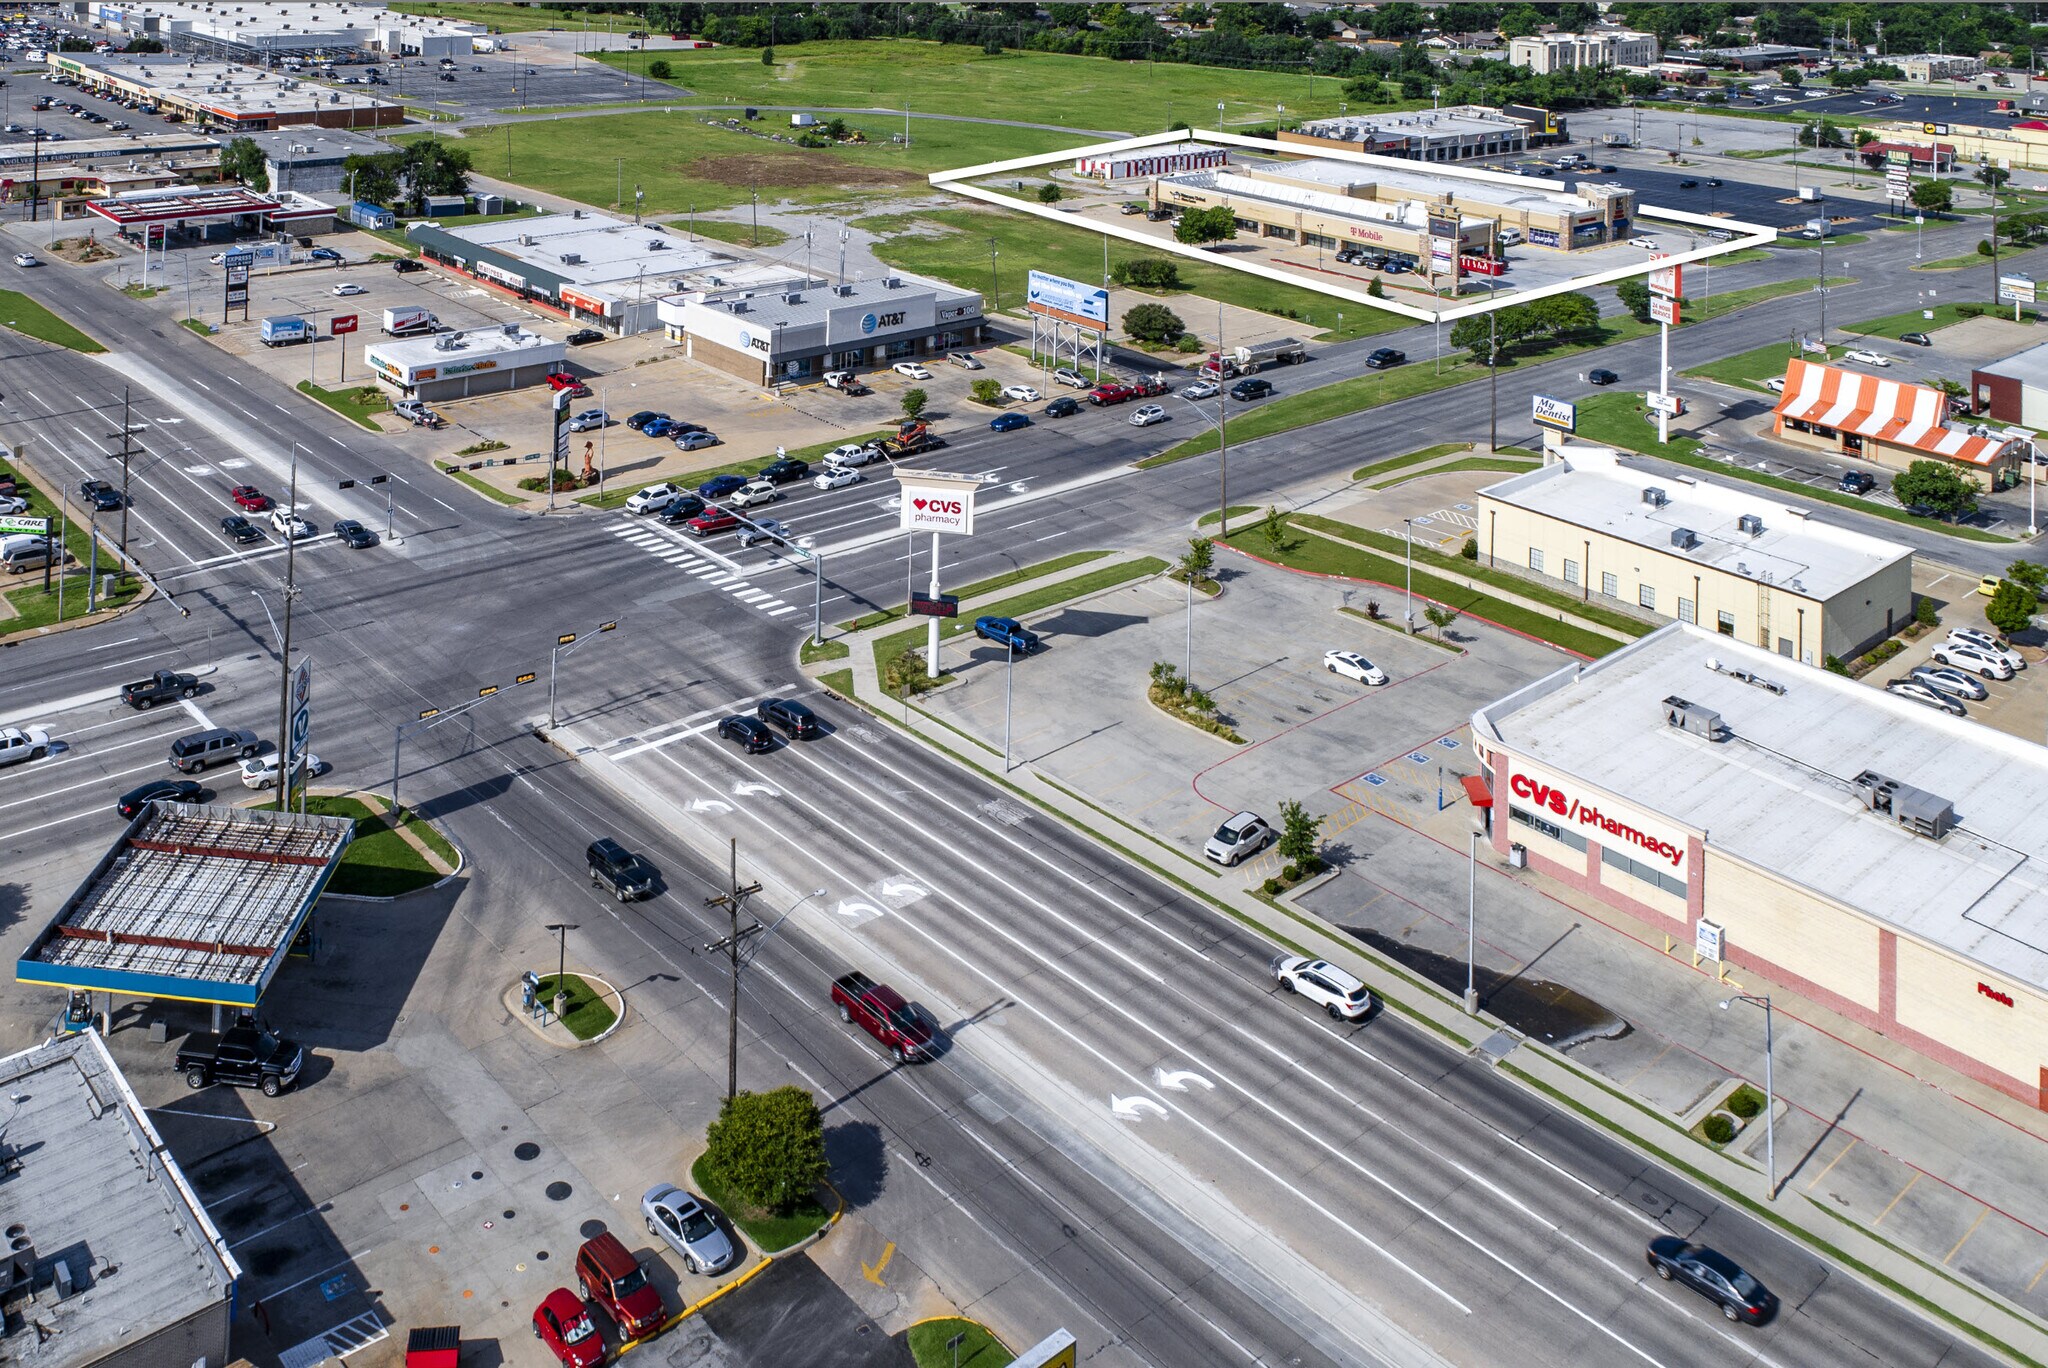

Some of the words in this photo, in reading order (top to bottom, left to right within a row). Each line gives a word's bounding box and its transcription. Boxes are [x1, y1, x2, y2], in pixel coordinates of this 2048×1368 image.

[3, 155, 48, 165] WOLVERON
[50, 153, 89, 161] FURNITURE
[93, 150, 121, 158] BEDDING
[1358, 228, 1384, 241] Mobile
[1534, 235, 1554, 245] purple
[478, 263, 503, 279] Mattress
[509, 276, 522, 287] King
[962, 305, 975, 315] 100
[1652, 309, 1671, 319] SERVICE
[1658, 304, 1671, 313] HOUR
[877, 311, 906, 328] AT&T
[751, 337, 770, 353] AT&T
[1539, 398, 1555, 411] My
[1535, 405, 1571, 421] Dentist
[929, 499, 961, 514] CVS
[915, 513, 960, 526] pharmacy
[1978, 982, 2014, 1008] Photo
